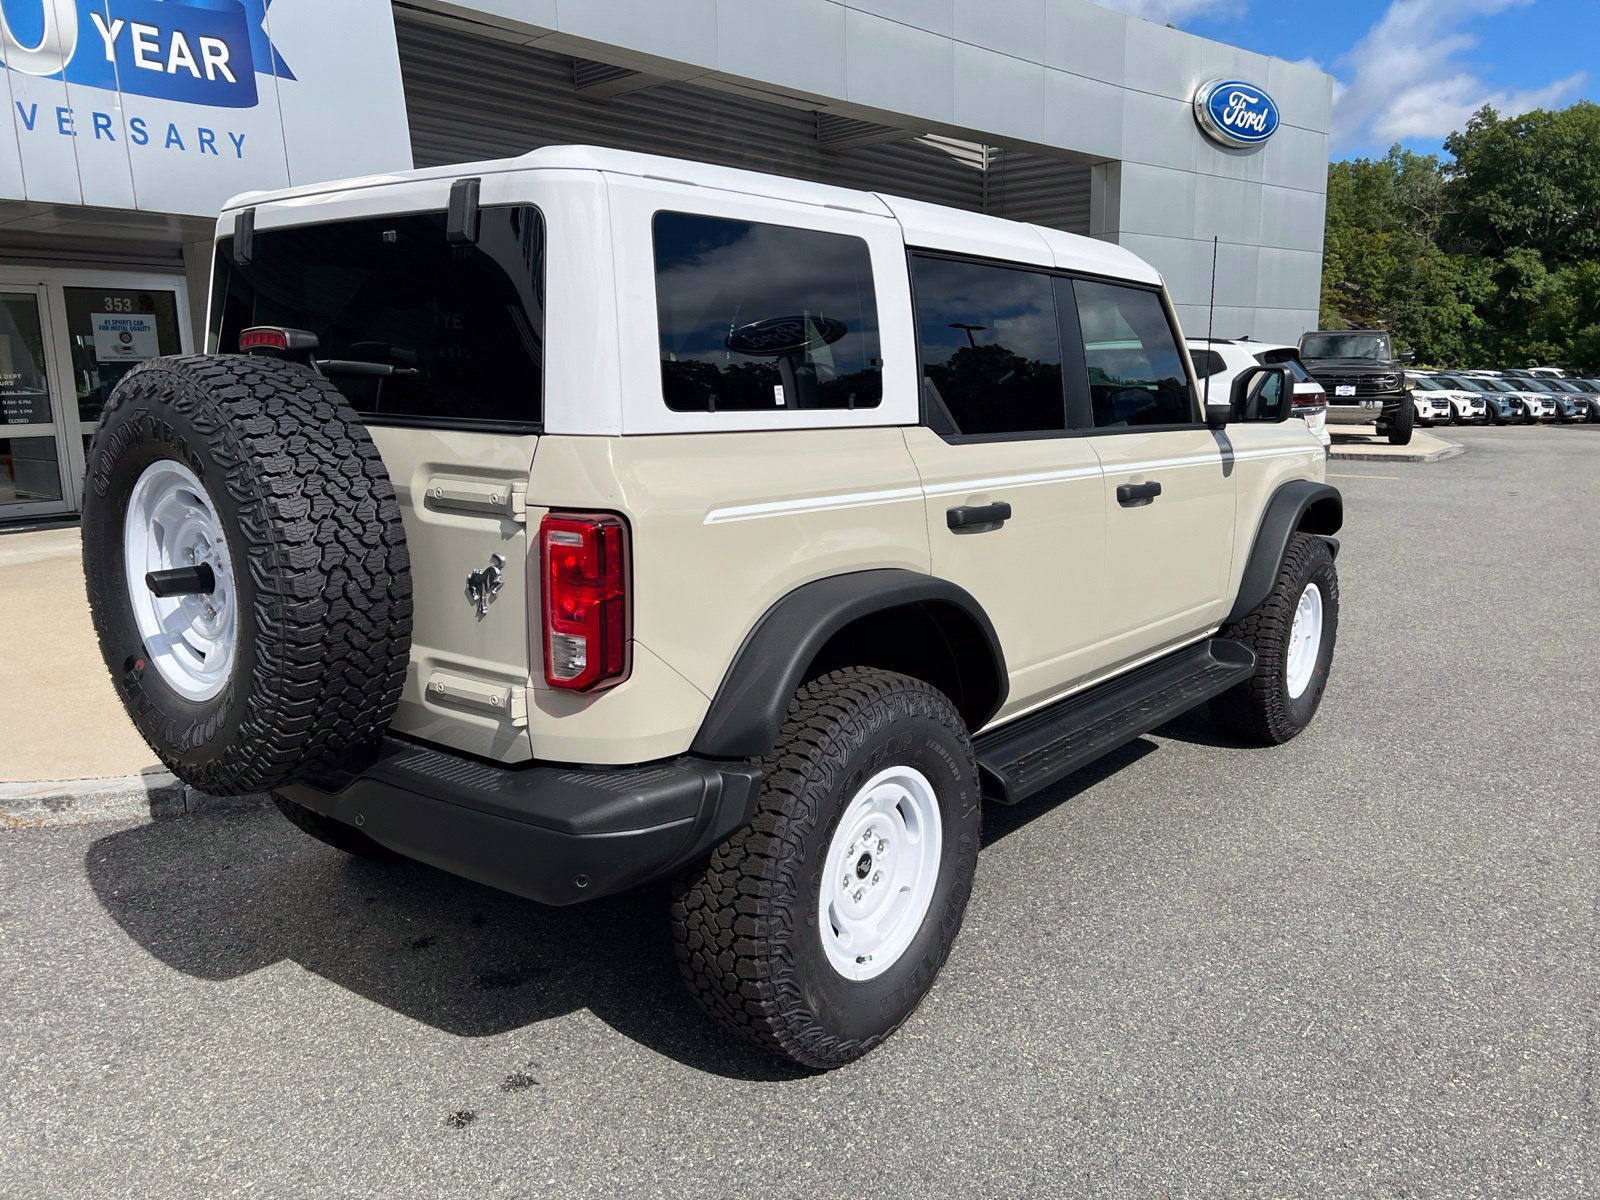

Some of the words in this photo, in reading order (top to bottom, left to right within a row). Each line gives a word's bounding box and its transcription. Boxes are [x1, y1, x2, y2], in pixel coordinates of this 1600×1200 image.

[90, 12, 237, 83] YEAR
[16, 101, 245, 158] VERSARY
[1223, 91, 1268, 132] Ford
[104, 297, 132, 312] 353
[926, 739, 961, 781] TERRITORY
